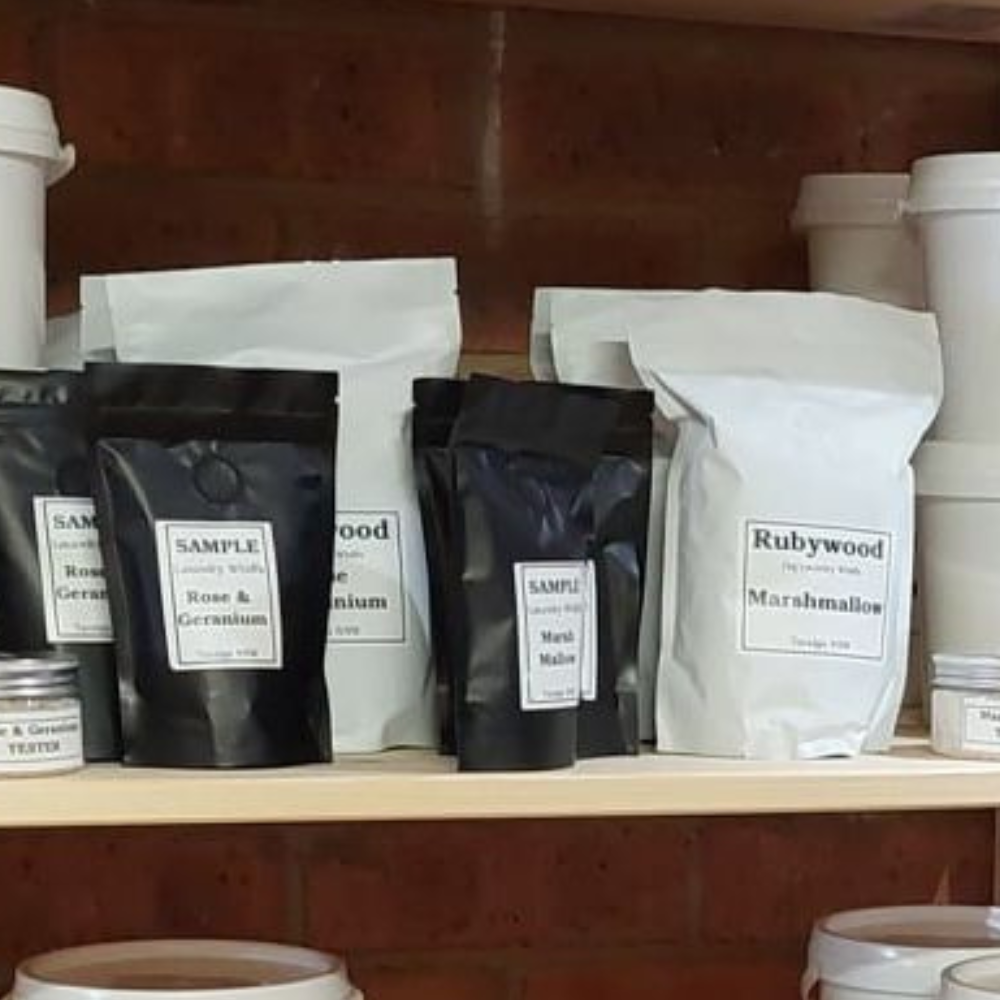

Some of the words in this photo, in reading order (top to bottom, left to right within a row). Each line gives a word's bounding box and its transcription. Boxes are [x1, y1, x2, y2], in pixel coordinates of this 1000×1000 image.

[175, 538, 261, 554] SAMPLE
[753, 528, 884, 560] Rubywood
[186, 589, 231, 605] Rose
[237, 590, 251, 604] &
[749, 588, 882, 616] Marshmallow
[178, 612, 268, 627] Geranium
